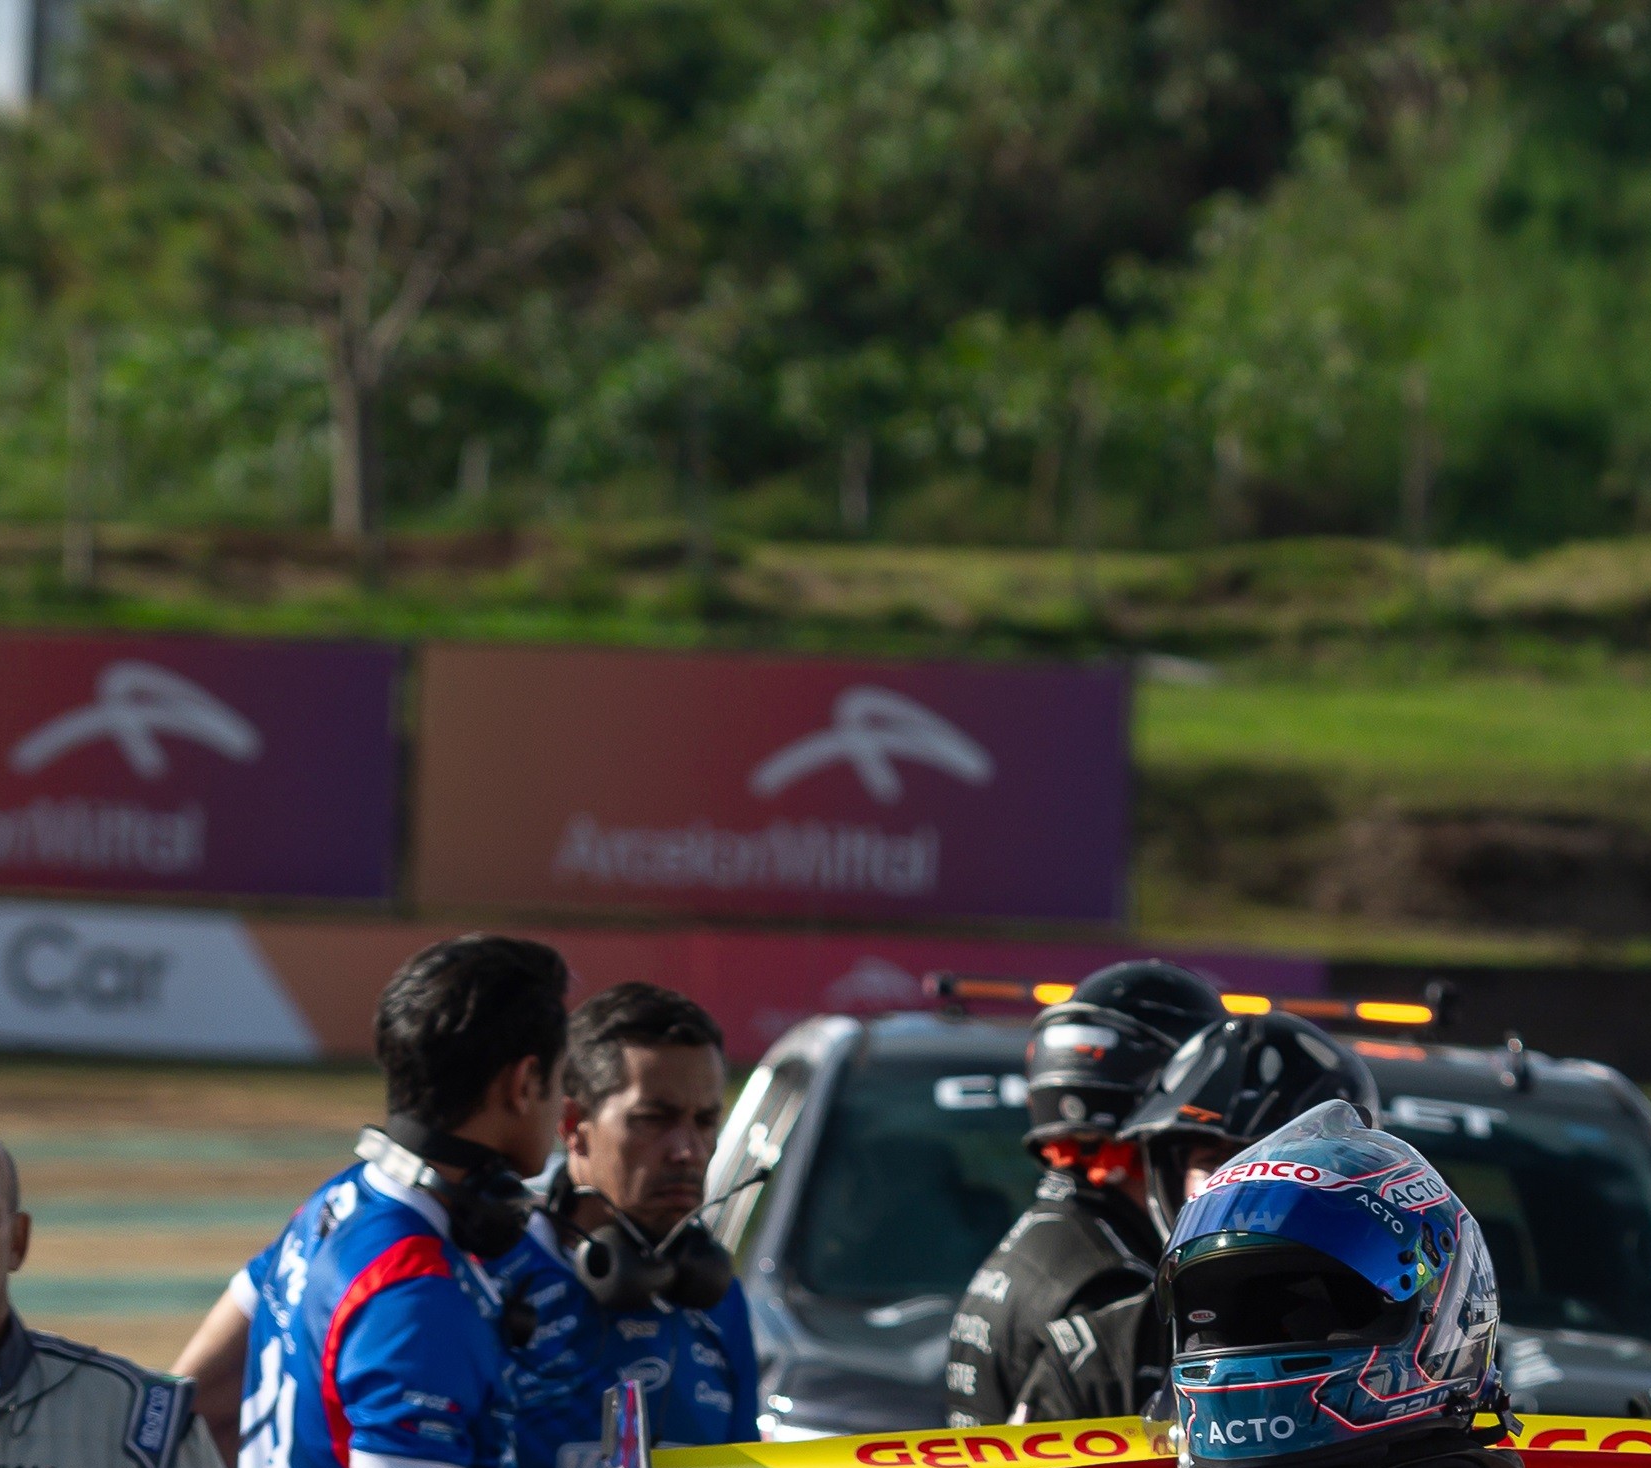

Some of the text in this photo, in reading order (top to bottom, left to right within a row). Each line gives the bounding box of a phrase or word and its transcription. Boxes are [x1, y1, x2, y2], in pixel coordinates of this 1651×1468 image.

[555, 816, 940, 897] ArcelorMittal
[1, 924, 175, 1011] Car
[1205, 1160, 1323, 1193] GENCO
[1389, 1174, 1445, 1209] ACTO
[1355, 1191, 1406, 1236] ACTO
[1206, 1413, 1297, 1446] ACTO
